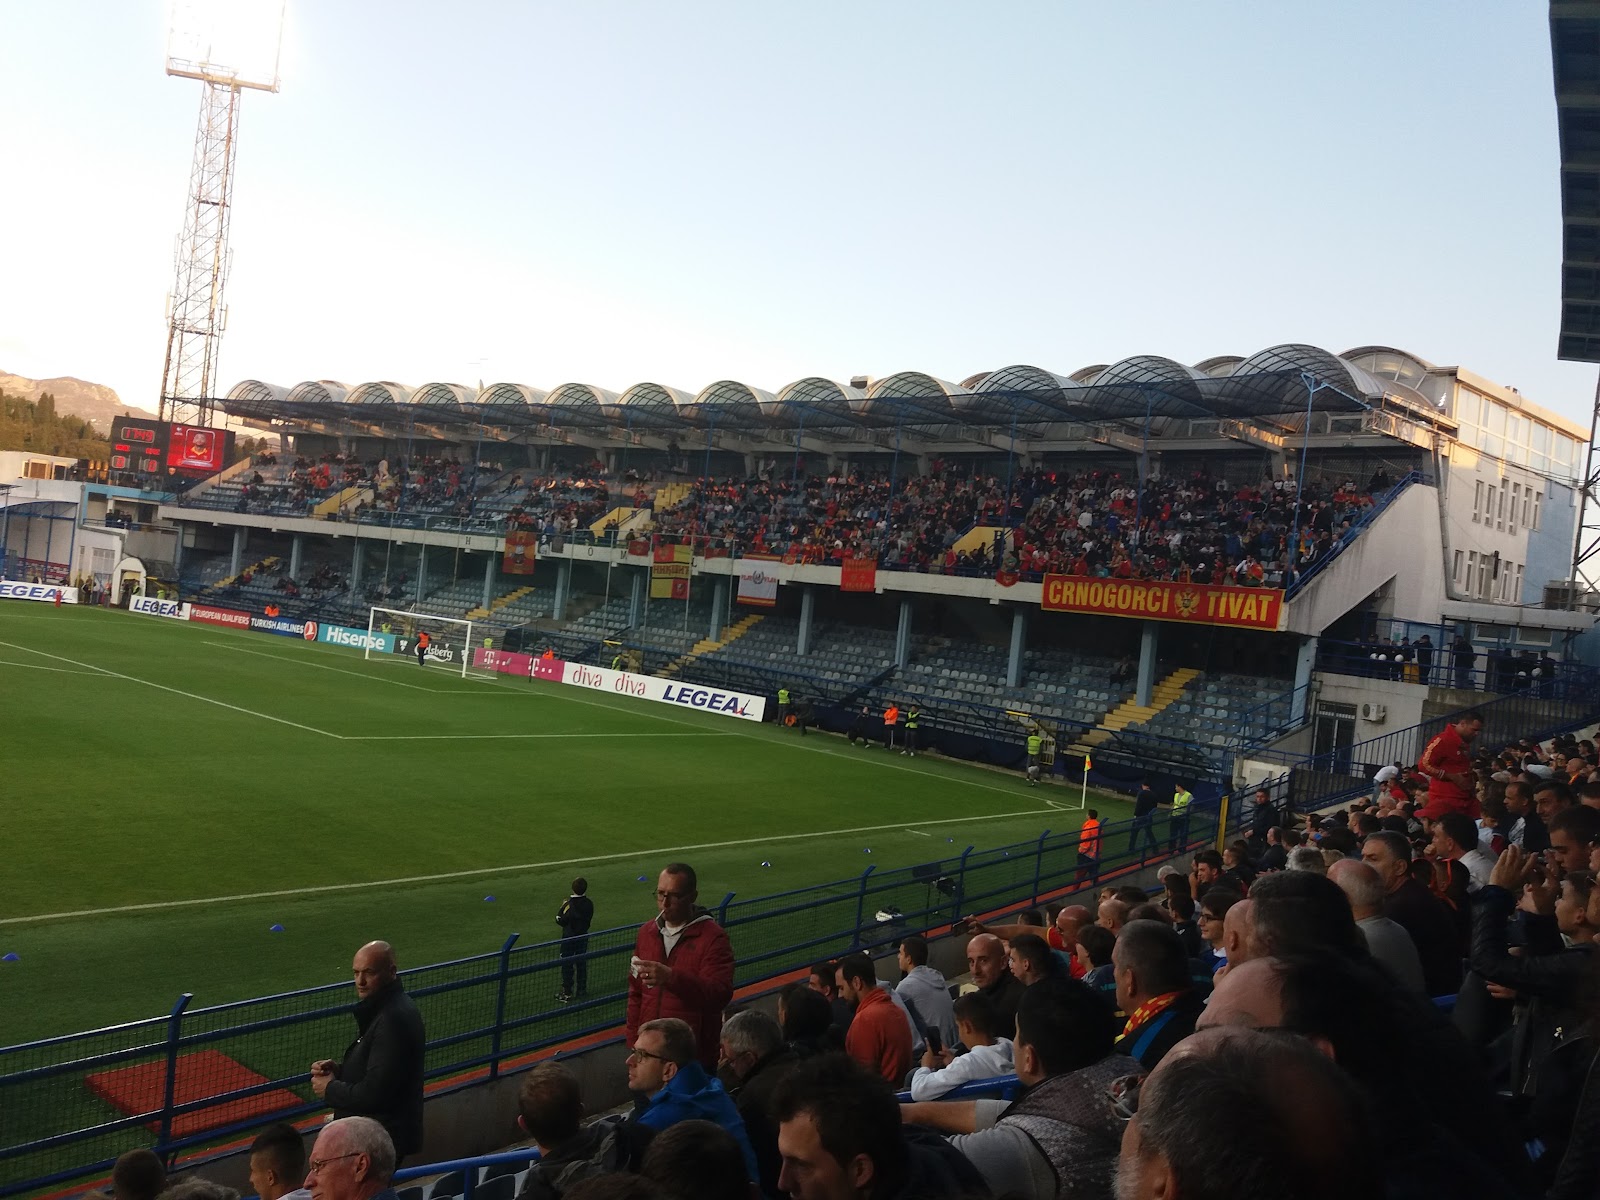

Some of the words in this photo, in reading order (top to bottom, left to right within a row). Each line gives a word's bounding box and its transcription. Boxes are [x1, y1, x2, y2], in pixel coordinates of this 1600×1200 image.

[0, 584, 57, 600] EGEA
[1048, 580, 1170, 613] CRNOGORCI
[1206, 591, 1273, 622] TIVAT
[133, 598, 177, 616] LEGEA
[195, 609, 221, 623] EUROPEAN
[221, 612, 250, 625] QUALIFIERS
[251, 617, 276, 630] TURKISH
[276, 621, 304, 635] AIRLINES
[326, 626, 385, 650] Hisense
[572, 665, 602, 687] diva
[615, 673, 646, 696] diva
[662, 684, 739, 714] LEGEA
